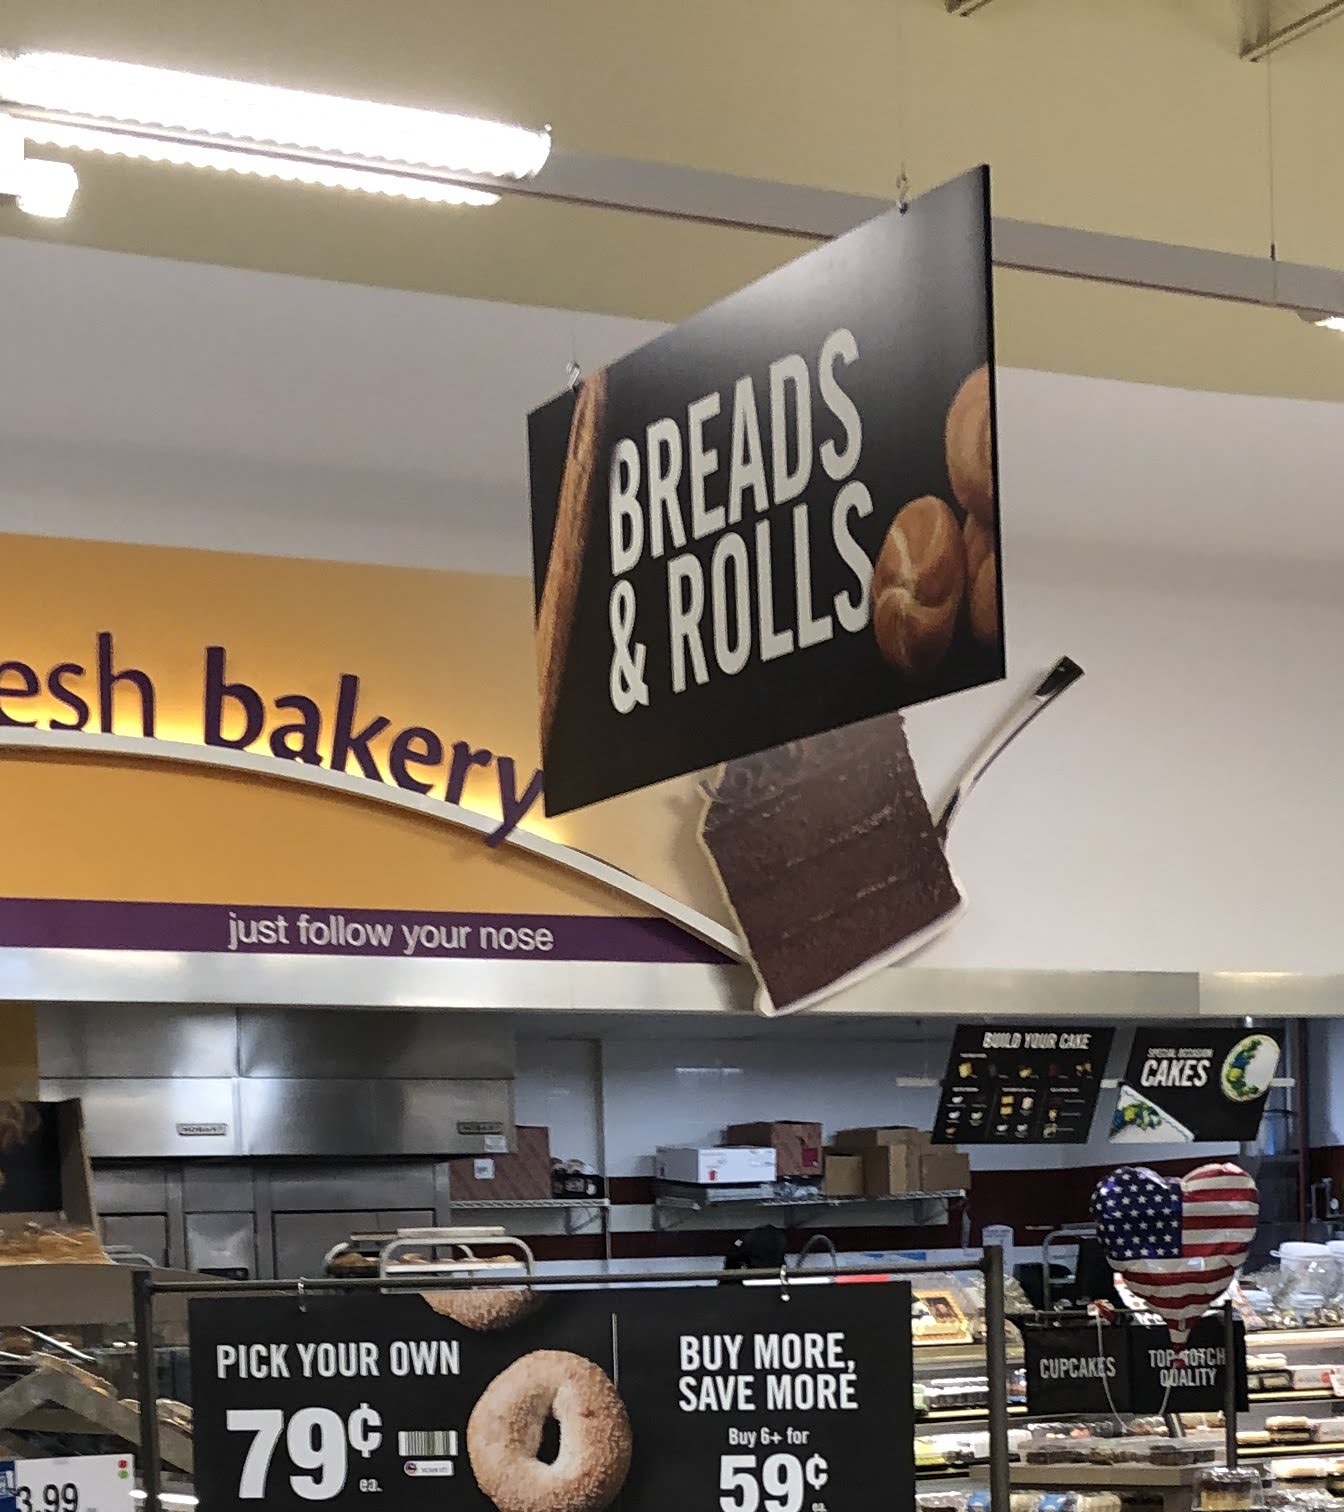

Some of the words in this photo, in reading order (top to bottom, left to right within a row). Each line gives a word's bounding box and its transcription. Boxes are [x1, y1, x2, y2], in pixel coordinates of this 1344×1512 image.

[609, 327, 864, 576] BREADS
[609, 580, 650, 715] &
[667, 479, 875, 695] ROLLS
[203, 644, 544, 848] bakery
[227, 912, 289, 950] just
[297, 914, 393, 947] follow
[402, 924, 472, 955] your
[480, 926, 554, 951] nose
[982, 1032, 1022, 1049] BUILD
[1024, 1033, 1058, 1049] YOUR
[1059, 1033, 1092, 1050] CAKE
[1140, 1059, 1211, 1087] CAKES
[216, 1343, 291, 1379] PICK
[296, 1342, 381, 1378] YOUR
[389, 1340, 461, 1376] OWN
[679, 1334, 744, 1371] BUY
[753, 1332, 856, 1373] MORE,
[1039, 1356, 1117, 1379] CUPCAKES
[1148, 1349, 1176, 1368] TOP
[678, 1375, 756, 1412] SAVE
[766, 1373, 859, 1410] MORE
[1159, 1368, 1218, 1388] QUALITY
[226, 1403, 383, 1501] 79¢
[728, 1427, 757, 1448] Buy
[760, 1426, 783, 1445] 6+
[786, 1426, 810, 1444] for
[358, 1478, 383, 1492] ea.
